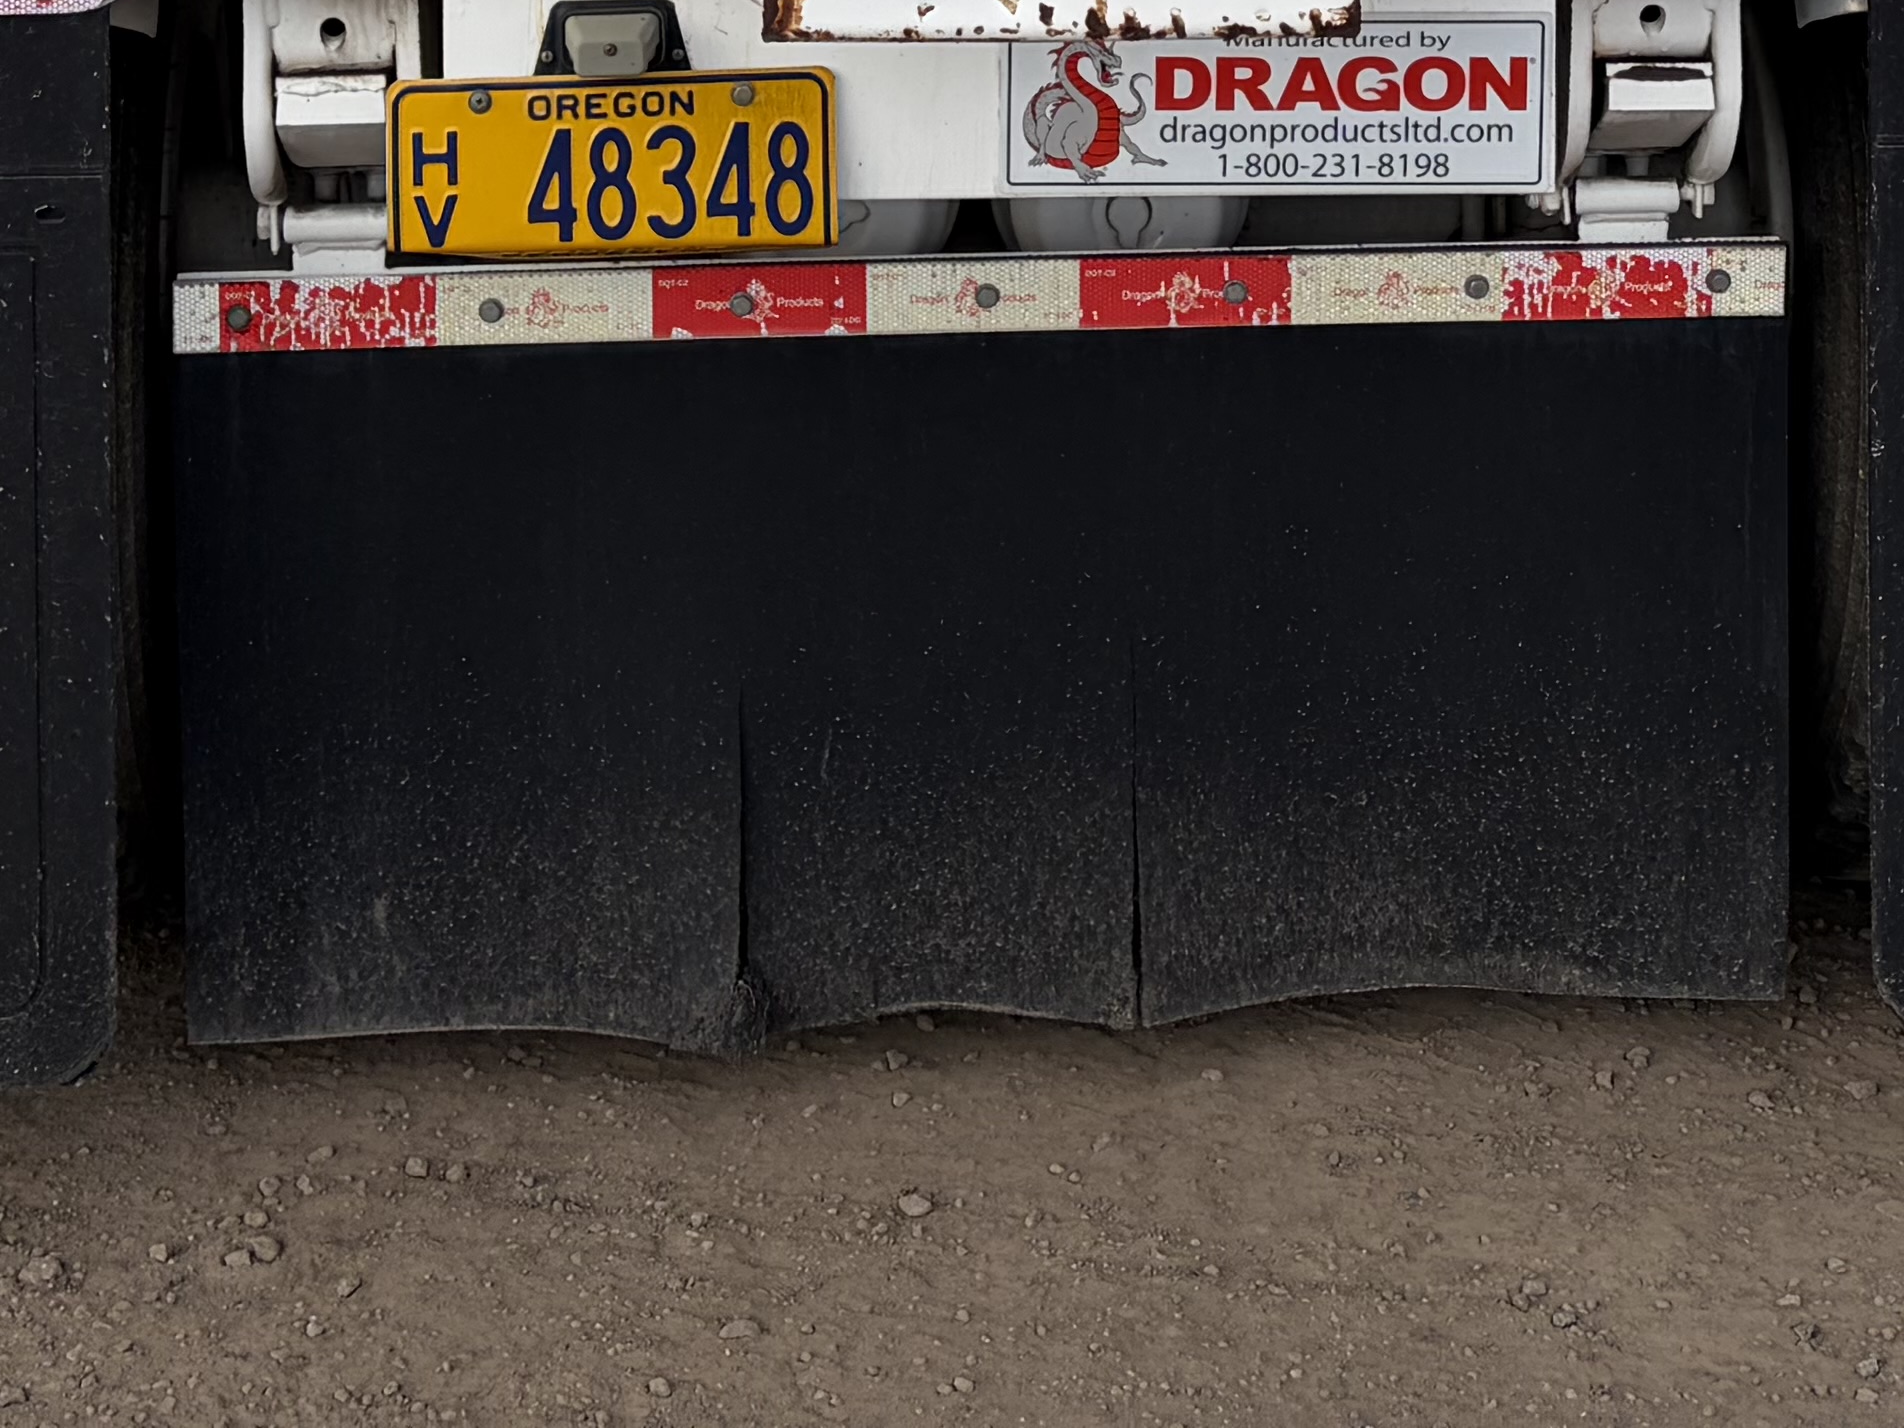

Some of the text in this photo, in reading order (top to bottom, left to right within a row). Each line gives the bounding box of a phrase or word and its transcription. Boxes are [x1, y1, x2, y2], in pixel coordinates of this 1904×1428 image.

[1420, 30, 1452, 52] by
[1154, 56, 1529, 112] DRAGON
[527, 89, 696, 122] OREGON
[1159, 115, 1514, 149] dragonproductsltd.com
[527, 120, 815, 243] 48348
[1217, 152, 1450, 179] 1-800-231-8198
[696, 296, 825, 313] Drago Products
